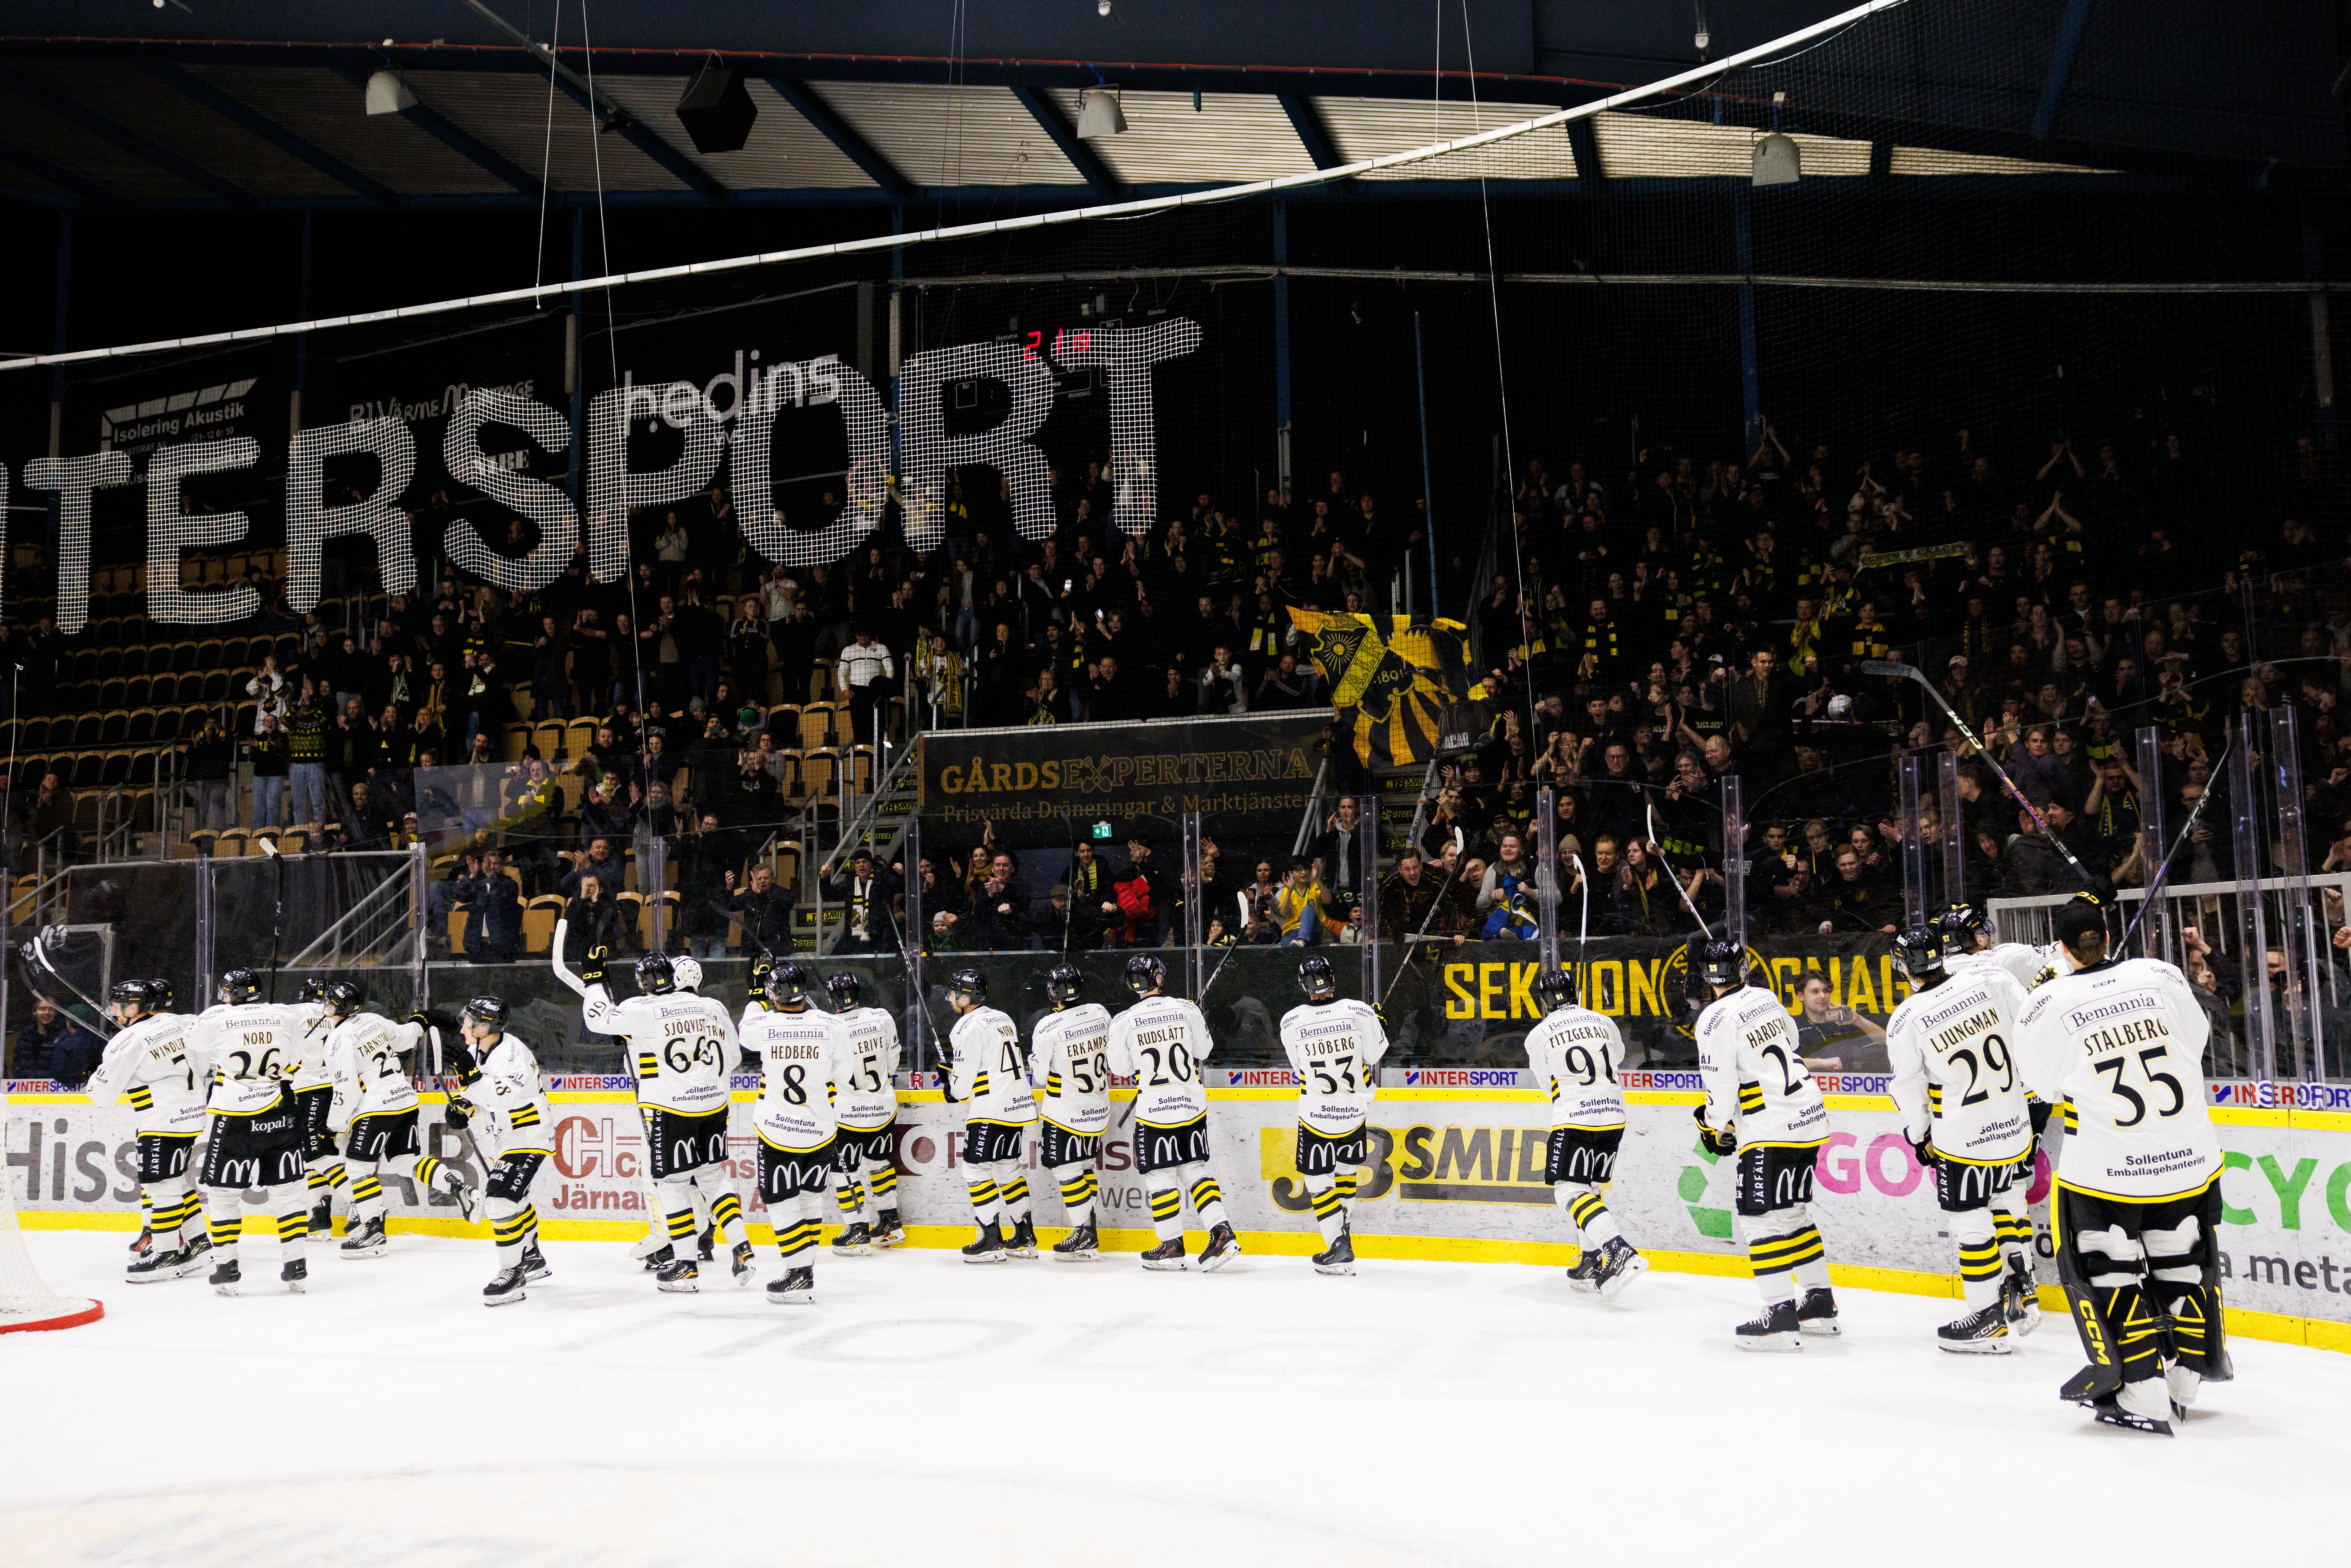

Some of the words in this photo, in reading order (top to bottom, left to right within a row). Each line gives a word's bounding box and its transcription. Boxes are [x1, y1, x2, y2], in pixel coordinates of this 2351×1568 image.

[995, 332, 1018, 342] Hemma
[623, 349, 841, 436] hedins
[114, 418, 180, 443] Isolering
[184, 402, 245, 428] Akustik
[0, 316, 1203, 635] TERSPORT
[944, 799, 1032, 823] Prisvärda
[1037, 795, 1157, 820] Dräneringar
[1161, 796, 1175, 813] &
[1183, 792, 1310, 815] Marktjänster
[1927, 949, 1936, 958] 29
[1444, 959, 1662, 1019] SEKION
[1936, 987, 1953, 998] CCM
[2092, 979, 2116, 988] CCM
[661, 1006, 705, 1018] Bemannia
[1134, 1011, 1184, 1027] Bemannia
[1348, 1005, 1374, 1017] Sundsten
[1738, 999, 1778, 1024] Bemannia
[1921, 990, 1988, 1029] Bemannia
[2020, 994, 2052, 1026] Sundsten
[2070, 993, 2157, 1028] Bemannia
[225, 1018, 281, 1029] Bemannia
[665, 1018, 705, 1037] SJÖQVIST
[956, 1014, 975, 1035] Sundsten
[1039, 1017, 1063, 1035] Sundsten
[1064, 1021, 1106, 1040] Bemannia
[1300, 1021, 1352, 1039] Bemannia
[1703, 1006, 1726, 1037] Sundsten
[1713, 1016, 1725, 1030] Måleri
[1888, 1007, 1912, 1039] Sundsten
[1929, 1007, 2000, 1054] LJUNGMAN
[243, 1031, 272, 1045] NORD
[768, 1028, 824, 1039] Bemannia
[1137, 1025, 1184, 1047] RUDSLÄTT
[1549, 1026, 1609, 1049] FITZGERALD
[2084, 1018, 2169, 1057] STÅLBERG
[771, 1045, 819, 1059] HEDBERG
[1305, 1037, 1355, 1056] SJÖBERG
[171, 1053, 194, 1091] 7
[229, 1047, 283, 1081] 26
[1140, 1042, 1192, 1086] 20
[1565, 1042, 1618, 1086] 91
[1947, 1034, 2013, 1107] 29
[783, 1064, 807, 1105] 8
[1244, 1071, 1301, 1085] INTERS
[1310, 1056, 1356, 1095] 53
[1421, 1071, 1518, 1085] INTERSPORT
[1617, 1072, 1703, 1089] TERSPORT
[1813, 1075, 1893, 1093] ERSPORT
[2093, 1044, 2185, 1127] 35
[333, 1091, 344, 1106] 23
[1158, 1095, 1191, 1104] Sollentuna
[841, 1110, 891, 1119] Emballagehantering
[1321, 1105, 1359, 1114] Sollentuna
[250, 1116, 286, 1134] kopal
[764, 1119, 823, 1136] Emballagehantering
[775, 1114, 815, 1127] Sollentuna
[208, 1138, 221, 1179] JÄRFÄLLA
[217, 1115, 228, 1133] KÖK
[308, 1135, 318, 1152] KÖK
[1399, 1125, 1548, 1181] SMID
[2106, 1155, 2206, 1177] Emballagehantering
[2126, 1148, 2193, 1166] Sollentuna
[1755, 1146, 1765, 1204] JÄRFÄLLA
[552, 1184, 647, 1211] Järna
[846, 1231, 862, 1246] CCM
[1583, 1266, 1594, 1278] CCM
[784, 1275, 804, 1292] CCM
[1972, 1320, 1998, 1339] CCM
[2078, 1299, 2111, 1365] CCM
